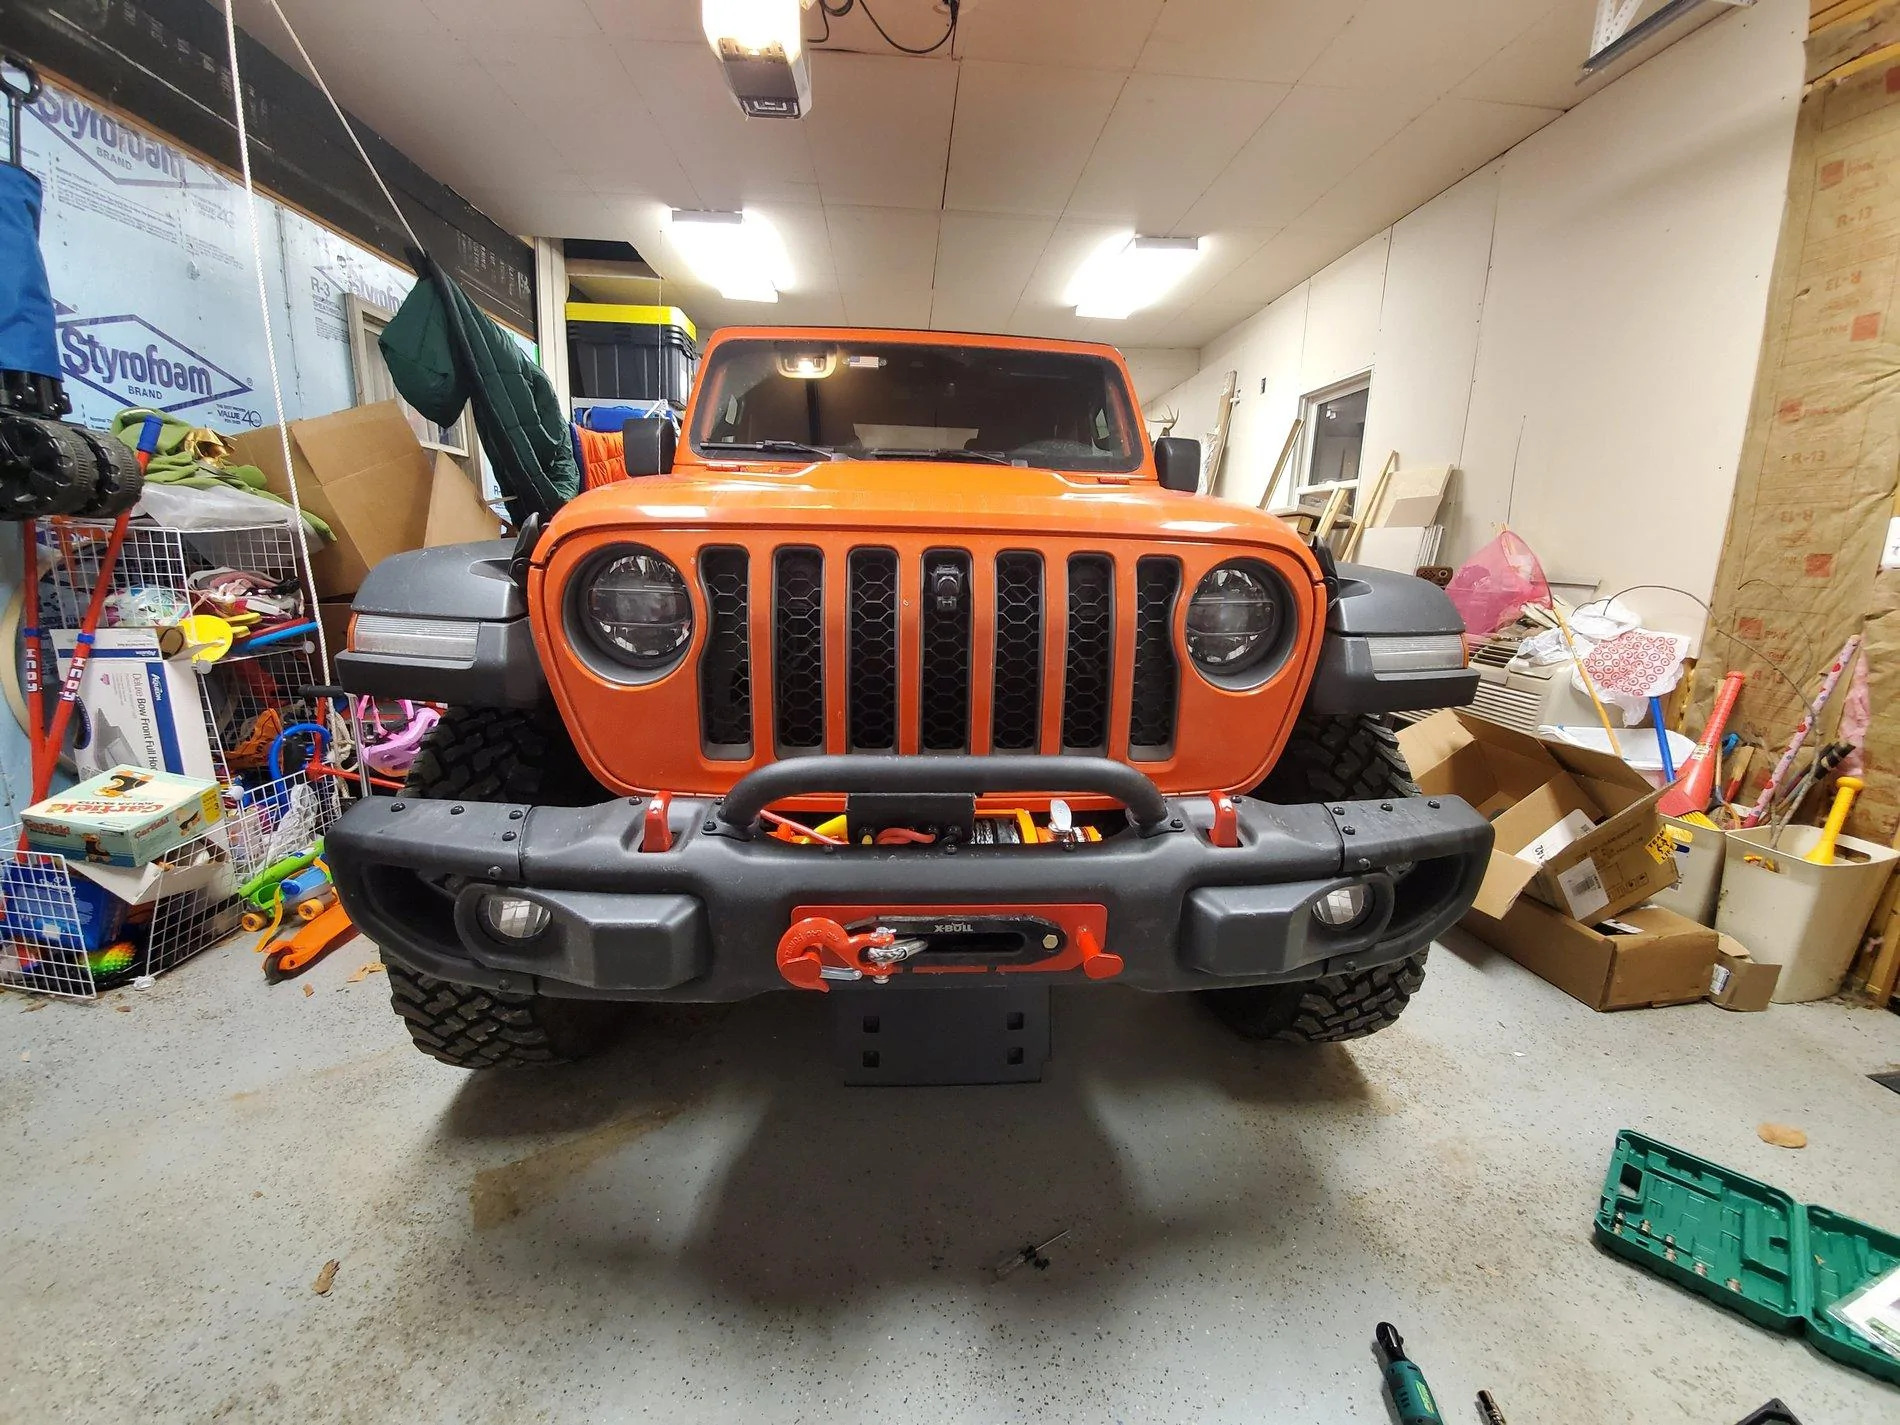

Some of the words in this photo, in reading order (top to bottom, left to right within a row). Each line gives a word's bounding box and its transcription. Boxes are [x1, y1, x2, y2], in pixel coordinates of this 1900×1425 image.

[37, 91, 188, 184] Styrofoam
[97, 147, 132, 170] BRAND
[311, 276, 331, 297] R-3
[62, 323, 213, 396] Styrofoam
[128, 385, 163, 400] BRAND
[217, 409, 241, 420] VALUE
[132, 673, 144, 697] Deluxe
[137, 698, 147, 716] Bow
[141, 717, 152, 741] Front
[146, 741, 156, 756] Full
[44, 802, 166, 815] Garfield
[1647, 830, 1665, 849] TEAM
[934, 922, 974, 933] X-BULL
